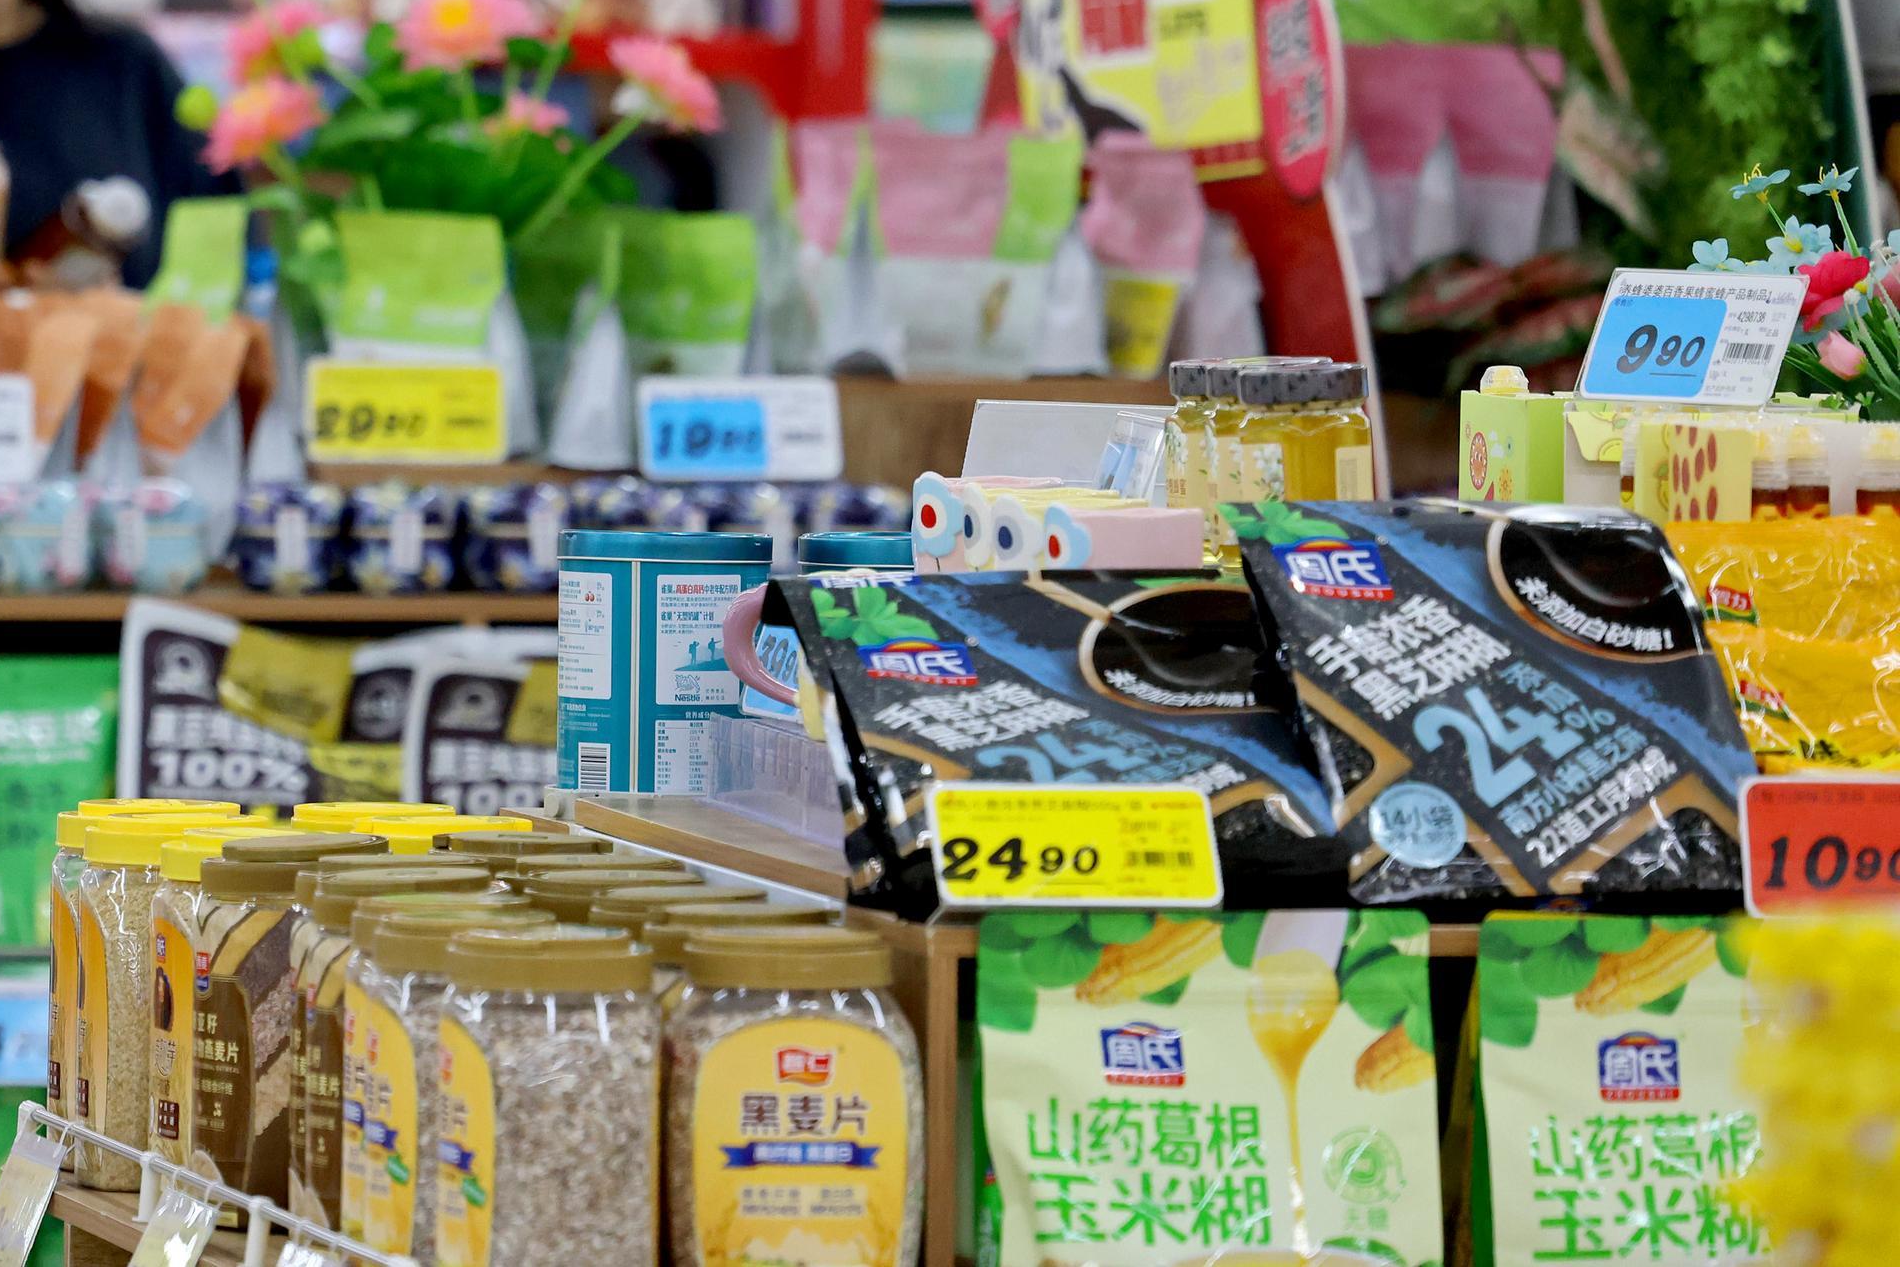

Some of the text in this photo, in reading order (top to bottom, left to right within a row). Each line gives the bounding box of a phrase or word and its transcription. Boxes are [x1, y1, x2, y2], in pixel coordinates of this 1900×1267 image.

[1306, 594, 1462, 681] 手磨浓香
[1351, 623, 1513, 721] 黑芝麻糊
[742, 1095, 868, 1135] 黑麦片
[1027, 1096, 1266, 1170] 山药葛根
[1531, 1111, 1764, 1180] 山药葛根
[1033, 1171, 1274, 1247] 玉米糊
